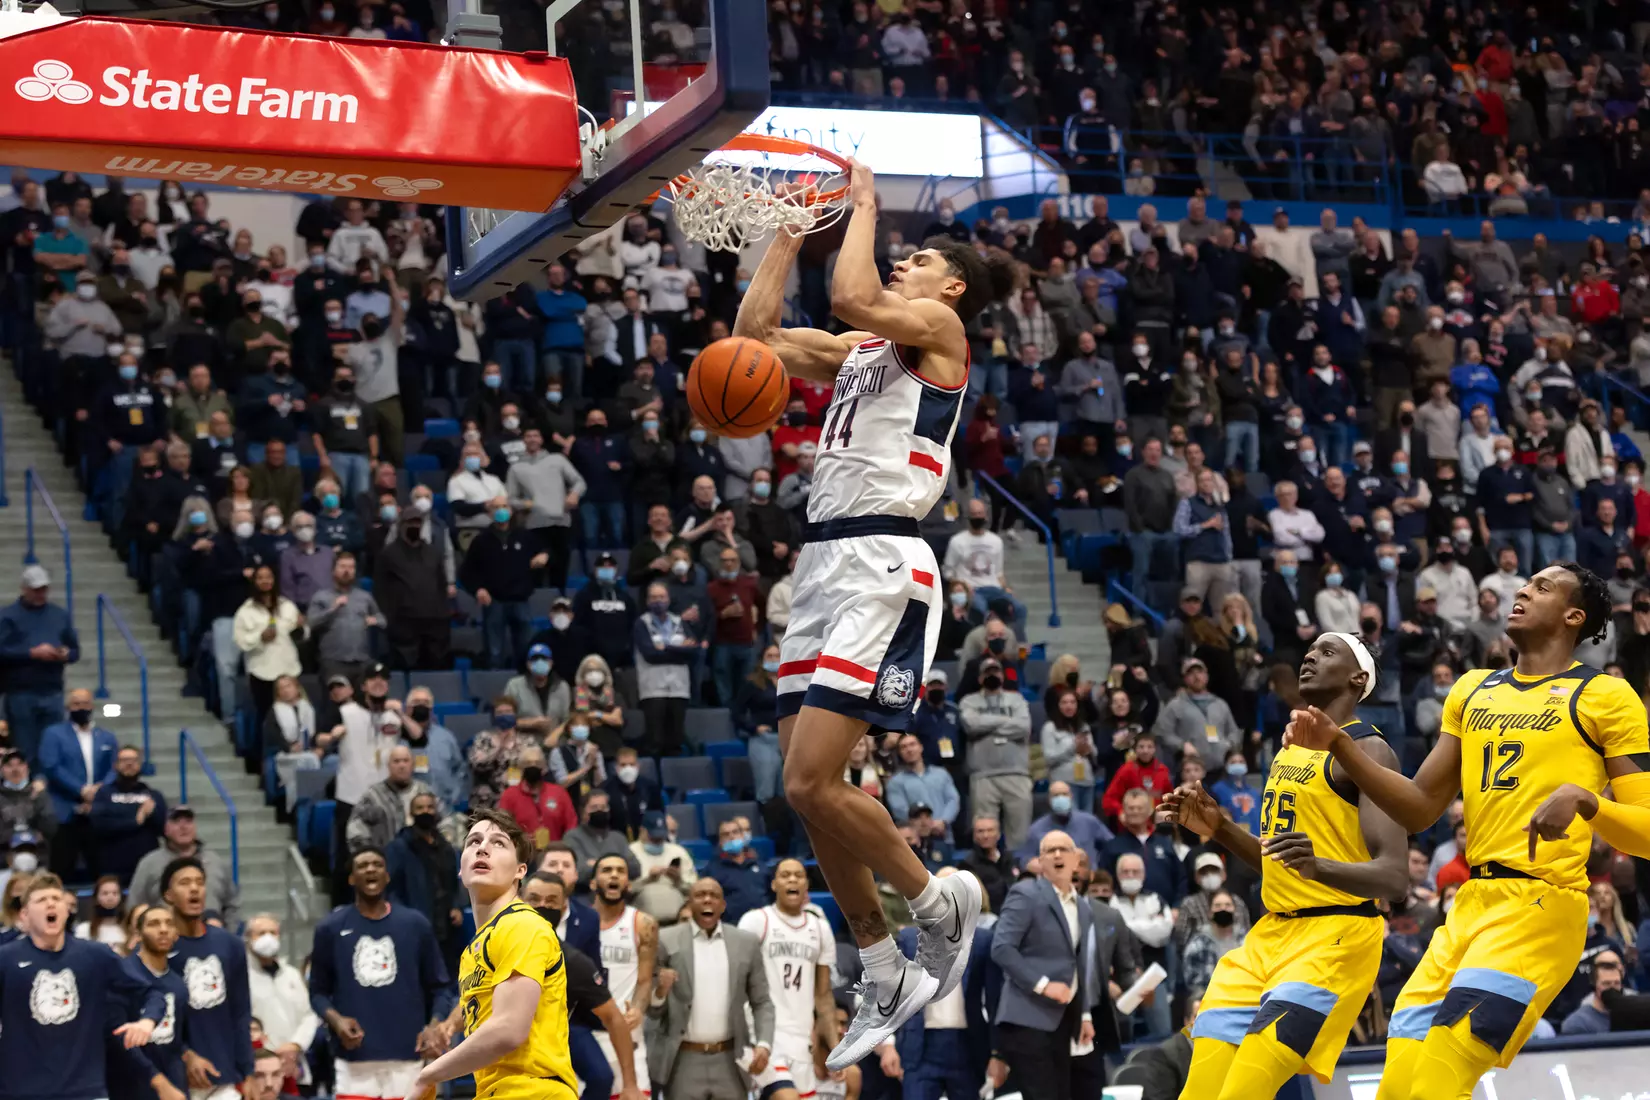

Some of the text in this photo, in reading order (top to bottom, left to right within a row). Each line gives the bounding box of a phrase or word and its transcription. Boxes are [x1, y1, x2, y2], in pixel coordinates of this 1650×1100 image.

[824, 397, 859, 450] 44
[1465, 707, 1562, 737] Marquette
[1480, 740, 1525, 793] 12
[1260, 788, 1297, 836] 35
[783, 963, 802, 992] 24
